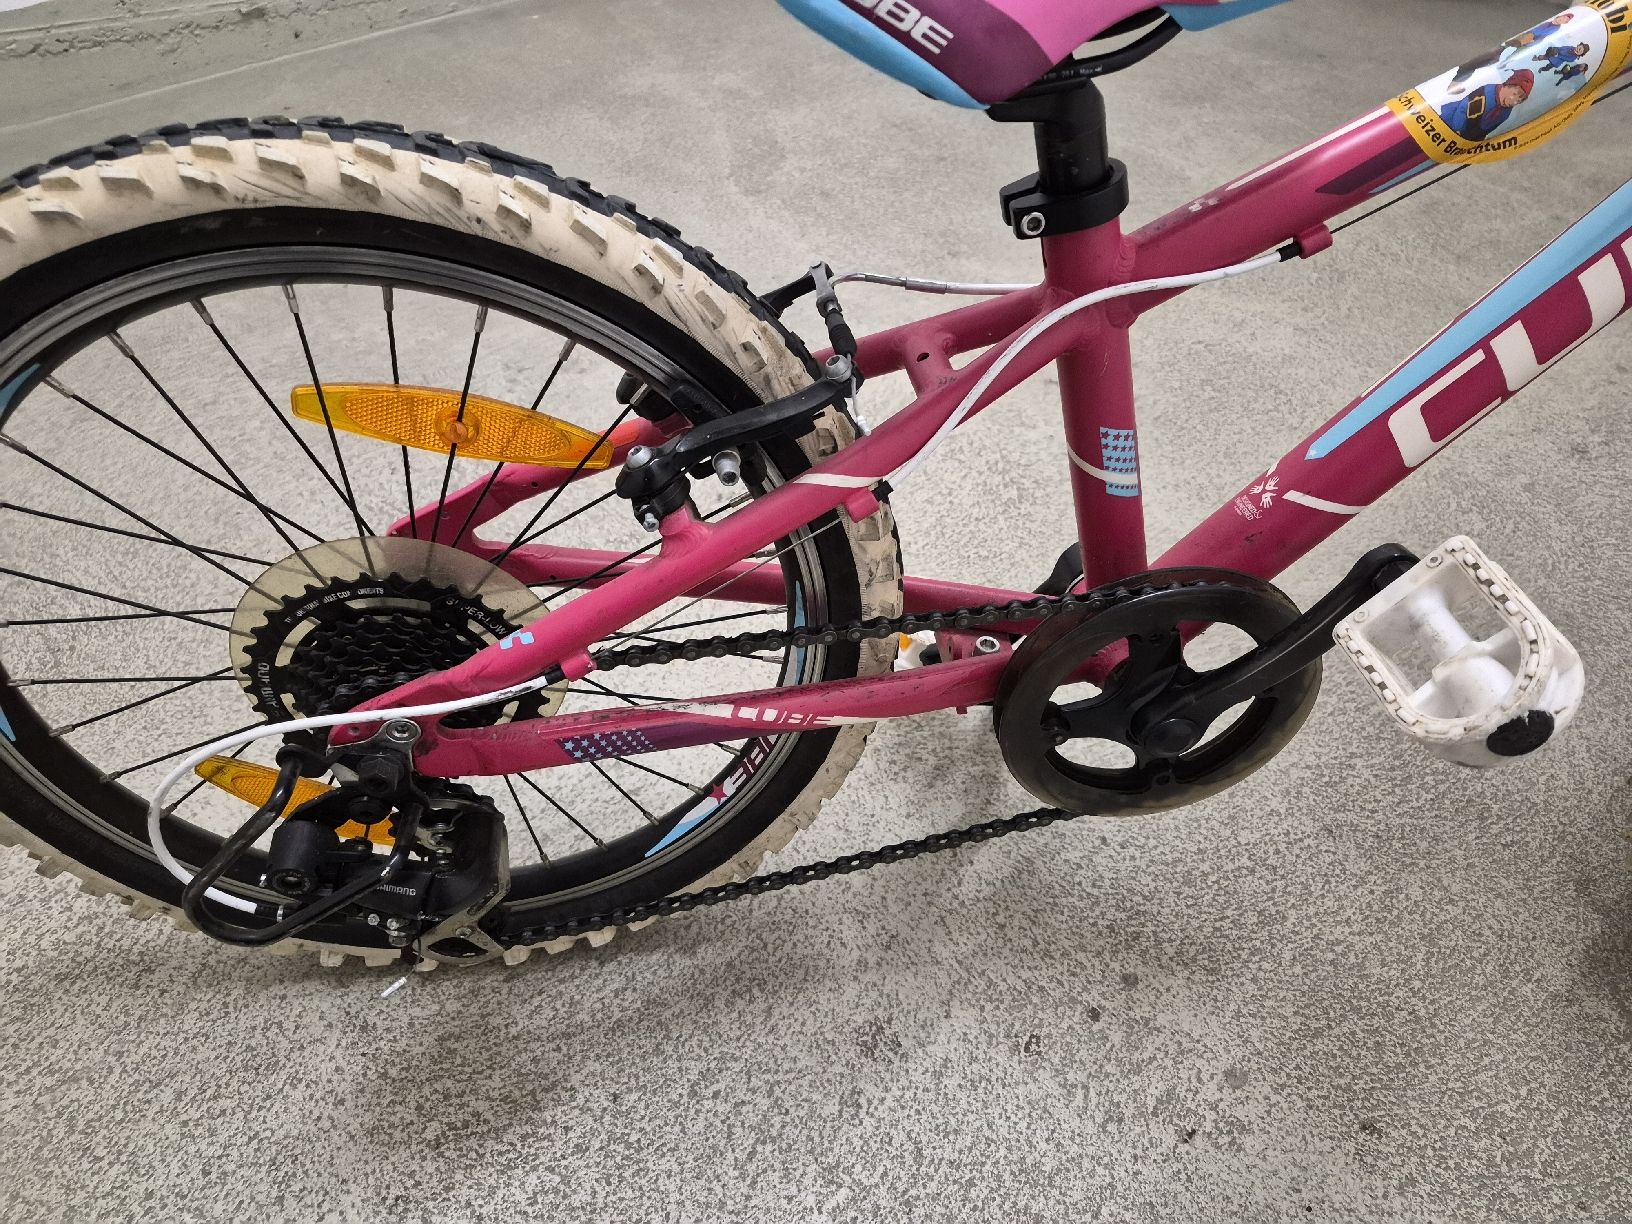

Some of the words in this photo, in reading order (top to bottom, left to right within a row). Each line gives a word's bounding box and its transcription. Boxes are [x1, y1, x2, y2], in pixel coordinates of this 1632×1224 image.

[852, 0, 954, 55] BE
[1387, 235, 1632, 468] CU
[376, 883, 417, 897] HIMANO
